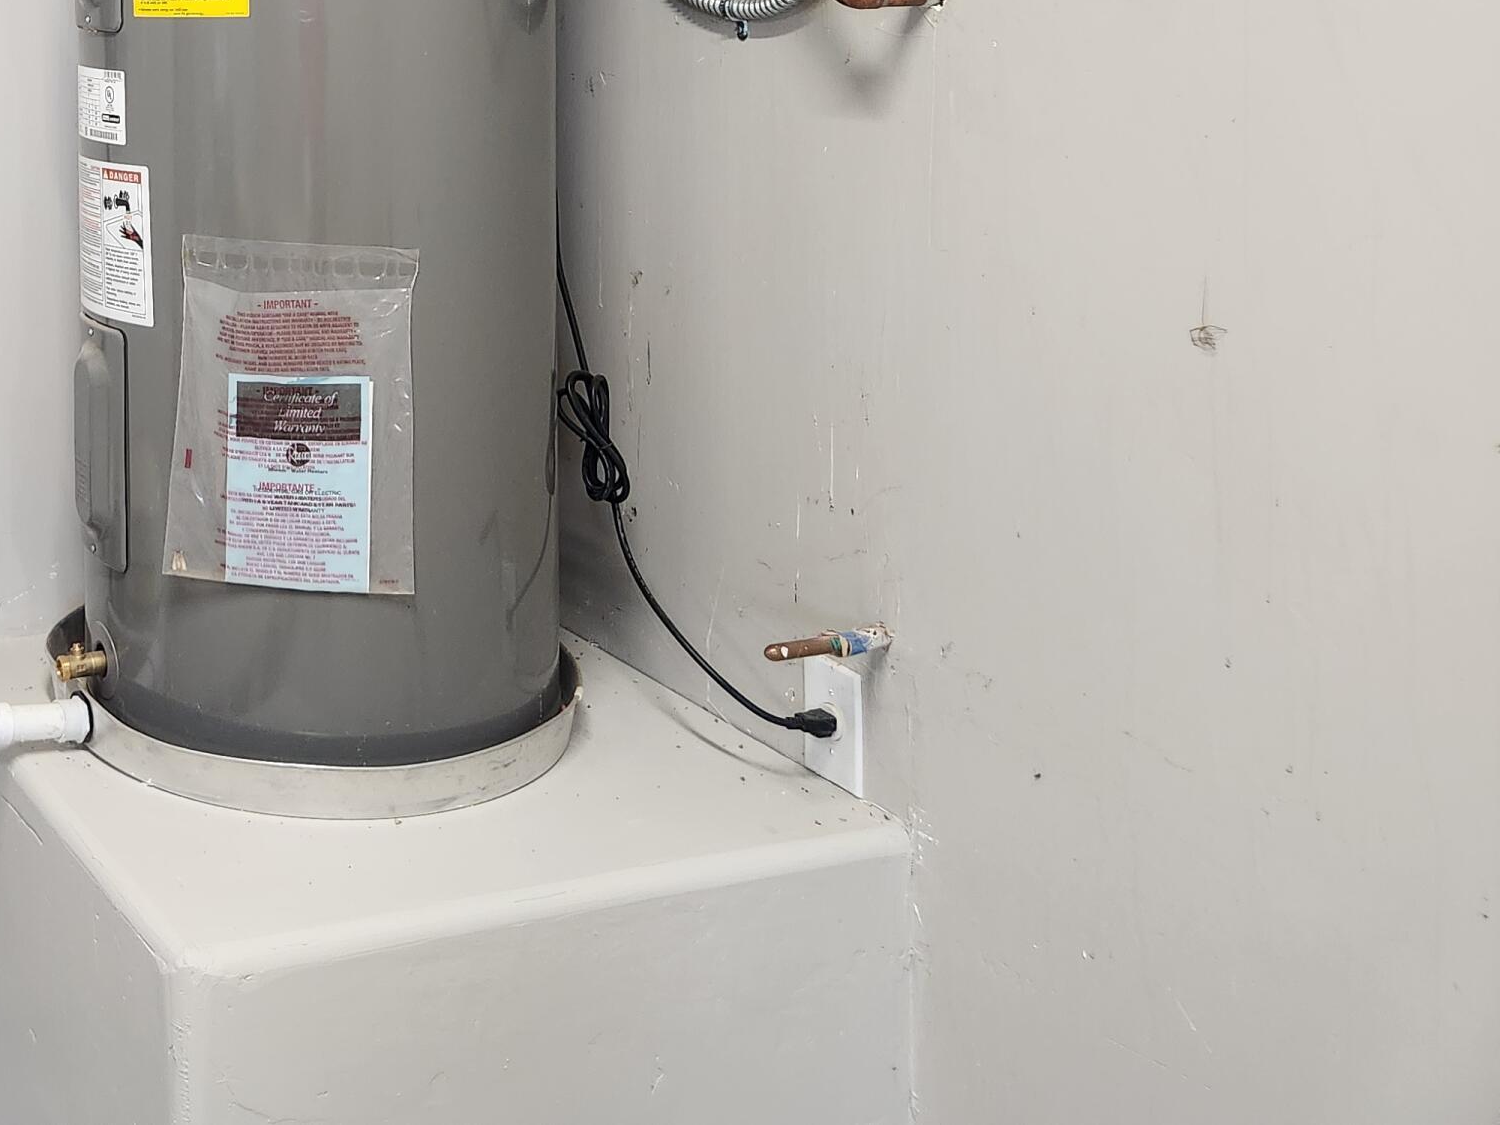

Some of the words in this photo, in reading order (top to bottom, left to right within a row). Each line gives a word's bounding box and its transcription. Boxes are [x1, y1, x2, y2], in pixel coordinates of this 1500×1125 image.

[109, 171, 139, 183] DANGER
[263, 299, 312, 309] IMPORTANT
[264, 390, 323, 404] Certificate
[324, 391, 338, 406] of
[278, 407, 322, 419] Limited
[273, 420, 326, 434] Warranty
